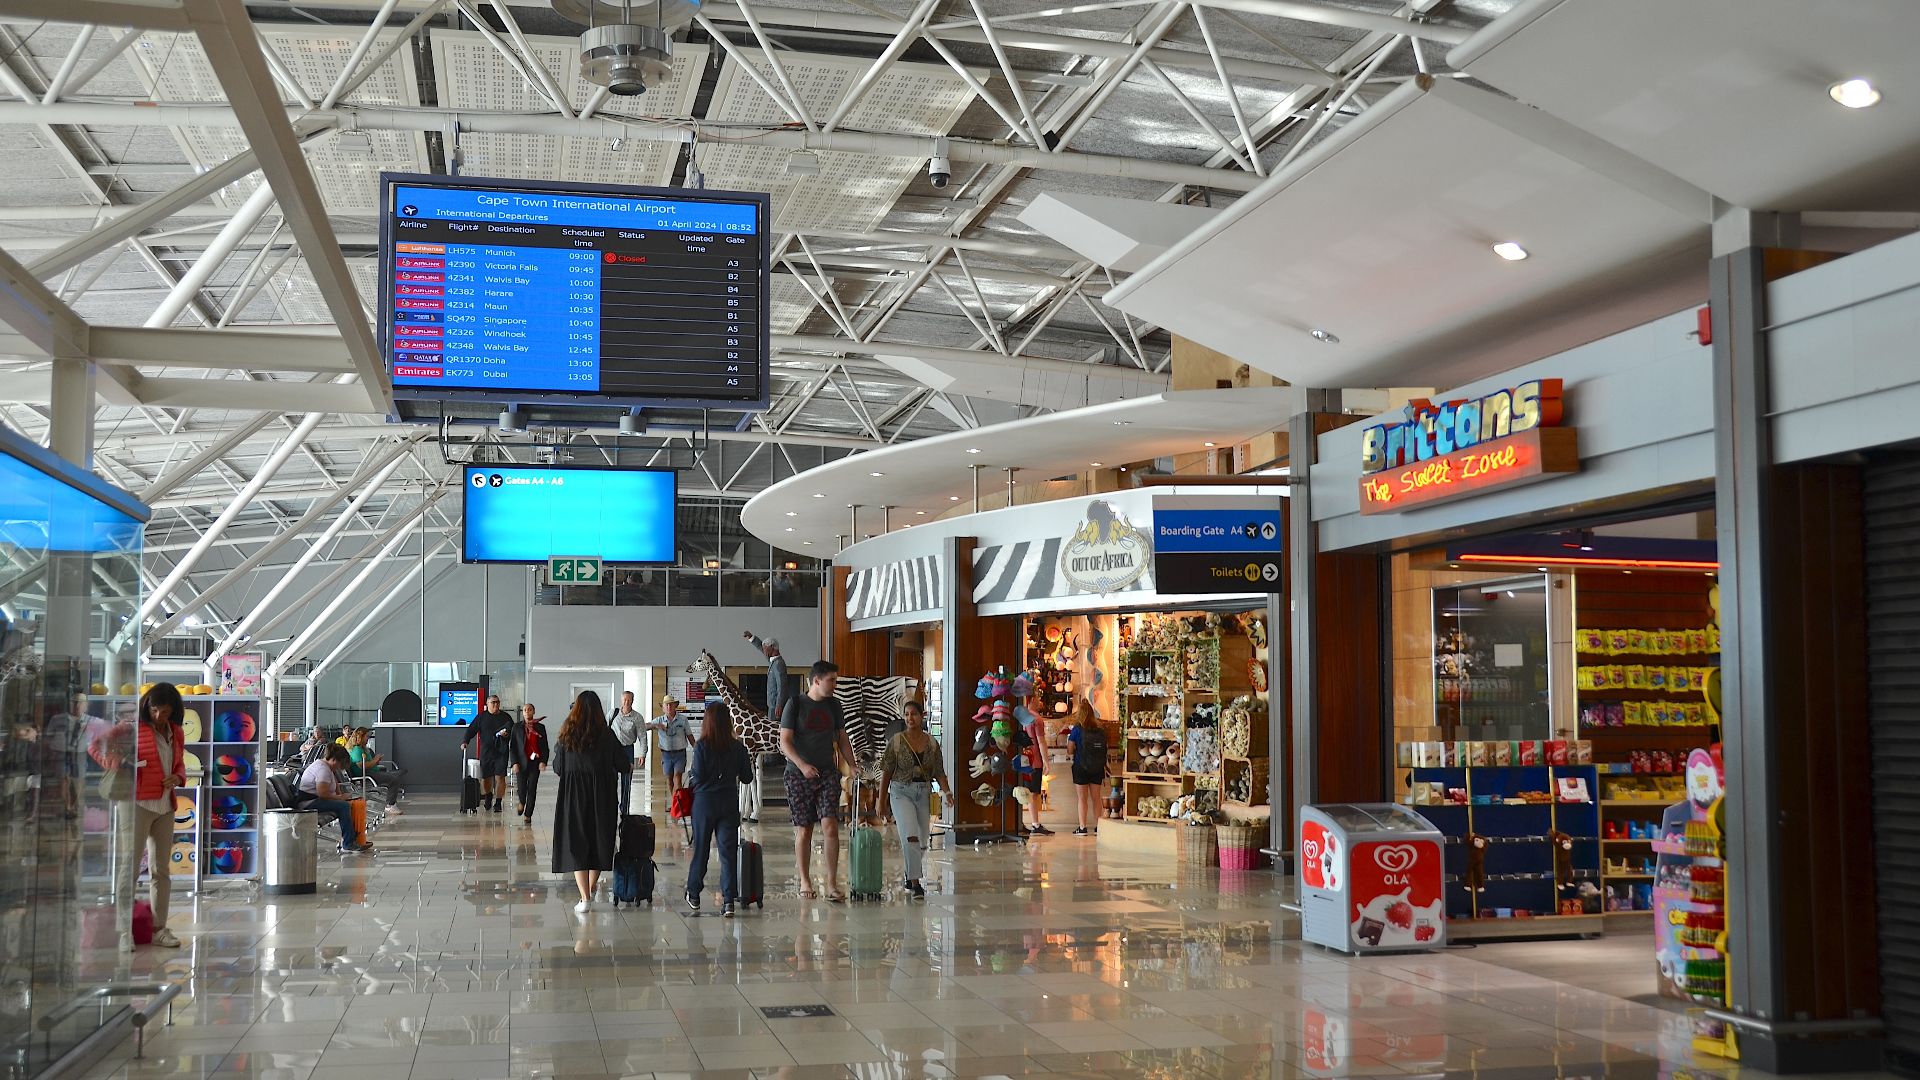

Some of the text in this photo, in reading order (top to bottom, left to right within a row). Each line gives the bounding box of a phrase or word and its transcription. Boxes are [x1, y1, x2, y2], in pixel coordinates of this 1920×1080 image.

[477, 195, 676, 215] Cape Town International Airport
[436, 209, 549, 221] International Departures
[400, 221, 428, 229] Airline
[448, 223, 479, 231] Flight#
[487, 225, 536, 234] Destination
[672, 220, 692, 229] April
[726, 223, 752, 231] 08:52
[562, 229, 605, 237] Scheduled
[618, 231, 645, 239] Status
[679, 234, 714, 243] Updated
[725, 236, 746, 244] Gate
[448, 247, 476, 255] LH575
[618, 255, 646, 263] Closed
[485, 262, 538, 272] Victoria Falls
[484, 275, 530, 285] Walvis Bay
[569, 279, 594, 287] 10:00
[446, 315, 476, 323] SQ479
[484, 316, 527, 325] Singapore
[483, 330, 526, 338] Windhoek
[483, 343, 529, 353] Walvis Bay
[446, 355, 481, 364] QR1370
[397, 368, 440, 376] Emirates
[483, 370, 508, 378] Dubai
[1362, 379, 1542, 474] Brittans
[1363, 445, 1517, 502] The Sweet Zone
[505, 477, 530, 485] Gates
[532, 477, 545, 485] A4
[1160, 526, 1243, 538] Boarding Gate A4
[1071, 549, 1134, 572] OUT OF AFRICA
[1210, 567, 1243, 577] Toilets
[1306, 860, 1316, 868] OLA
[1383, 874, 1409, 885] OLA
